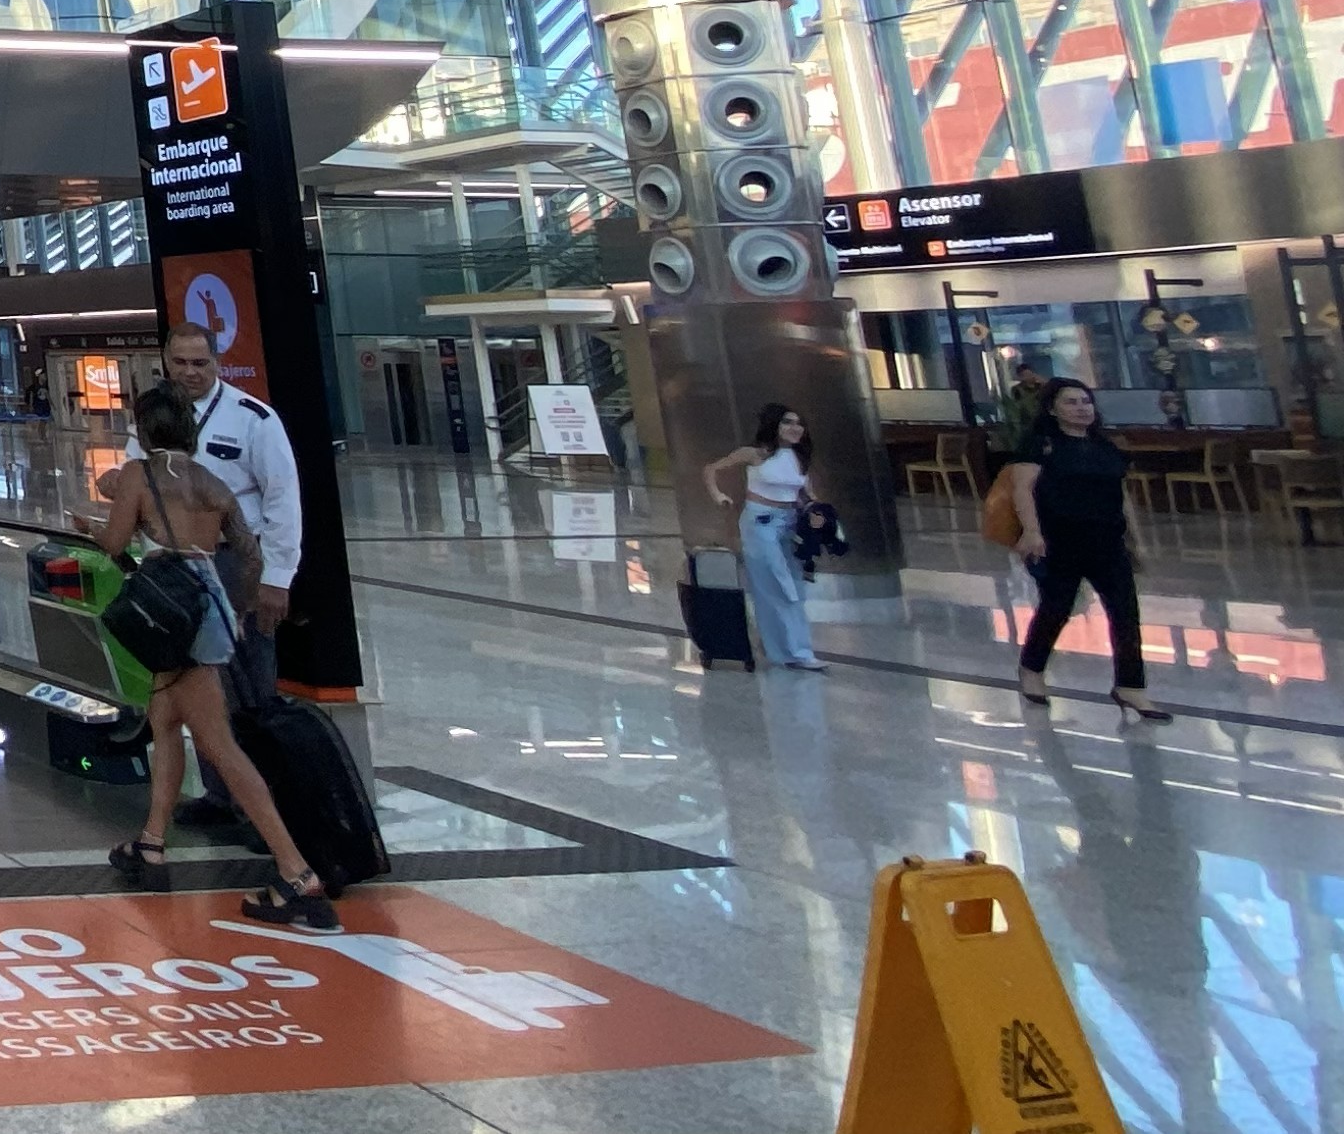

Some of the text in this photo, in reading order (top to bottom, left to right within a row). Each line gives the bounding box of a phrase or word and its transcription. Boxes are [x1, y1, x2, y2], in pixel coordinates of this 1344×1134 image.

[157, 135, 229, 162] Embarque
[150, 152, 242, 186] internacional
[166, 181, 230, 204] International
[899, 193, 982, 213] Ascensor
[166, 201, 235, 221] boarding area
[900, 214, 951, 228] Elevator
[218, 365, 256, 379] sajeros
[148, 999, 293, 1024] ONLY
